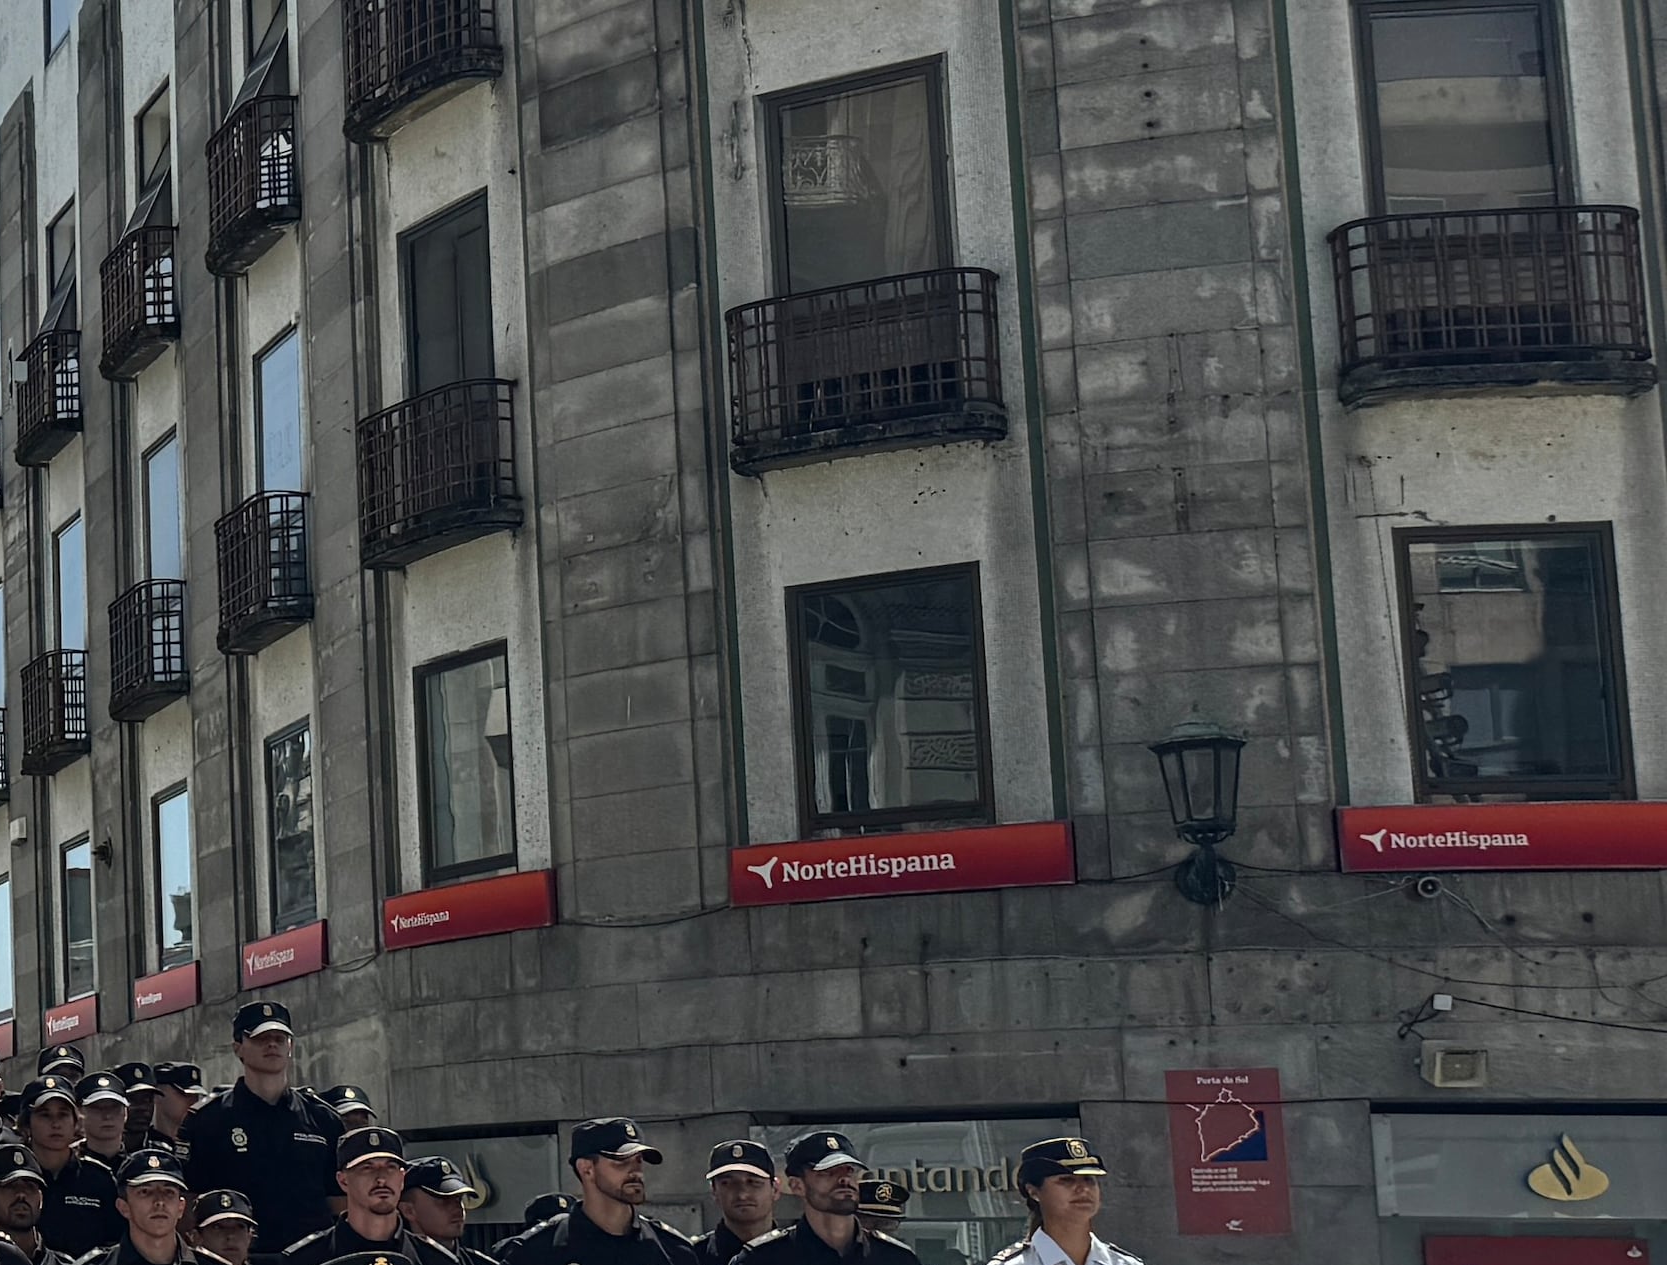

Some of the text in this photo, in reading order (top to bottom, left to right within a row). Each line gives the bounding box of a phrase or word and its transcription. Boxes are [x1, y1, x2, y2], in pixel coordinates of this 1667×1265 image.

[1391, 831, 1529, 850] NorteHispana
[782, 853, 955, 883] NorteHispana
[857, 1156, 1019, 1192] antand
